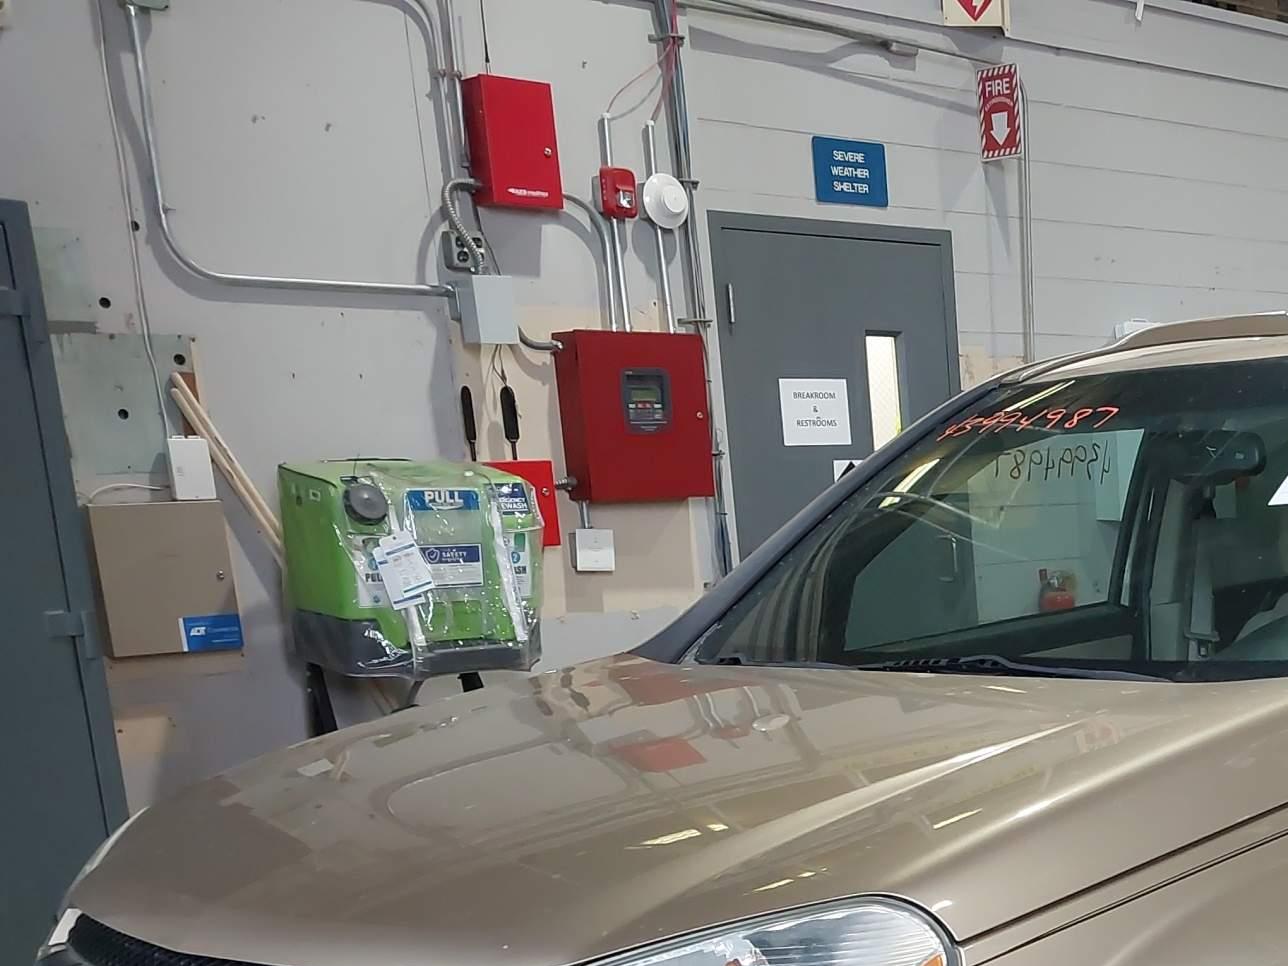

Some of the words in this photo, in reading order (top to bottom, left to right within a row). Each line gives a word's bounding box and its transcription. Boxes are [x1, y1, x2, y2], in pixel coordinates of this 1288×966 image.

[984, 78, 1011, 97] FIRE
[832, 150, 865, 163] SEVERE
[830, 165, 870, 178] WEATHER
[833, 181, 869, 194] SHELTER
[793, 391, 836, 400] BREAKROOM
[813, 405, 819, 413] &
[797, 419, 838, 428] RESTROOMS
[936, 407, 1120, 442] 43994987
[424, 491, 464, 503] PULL
